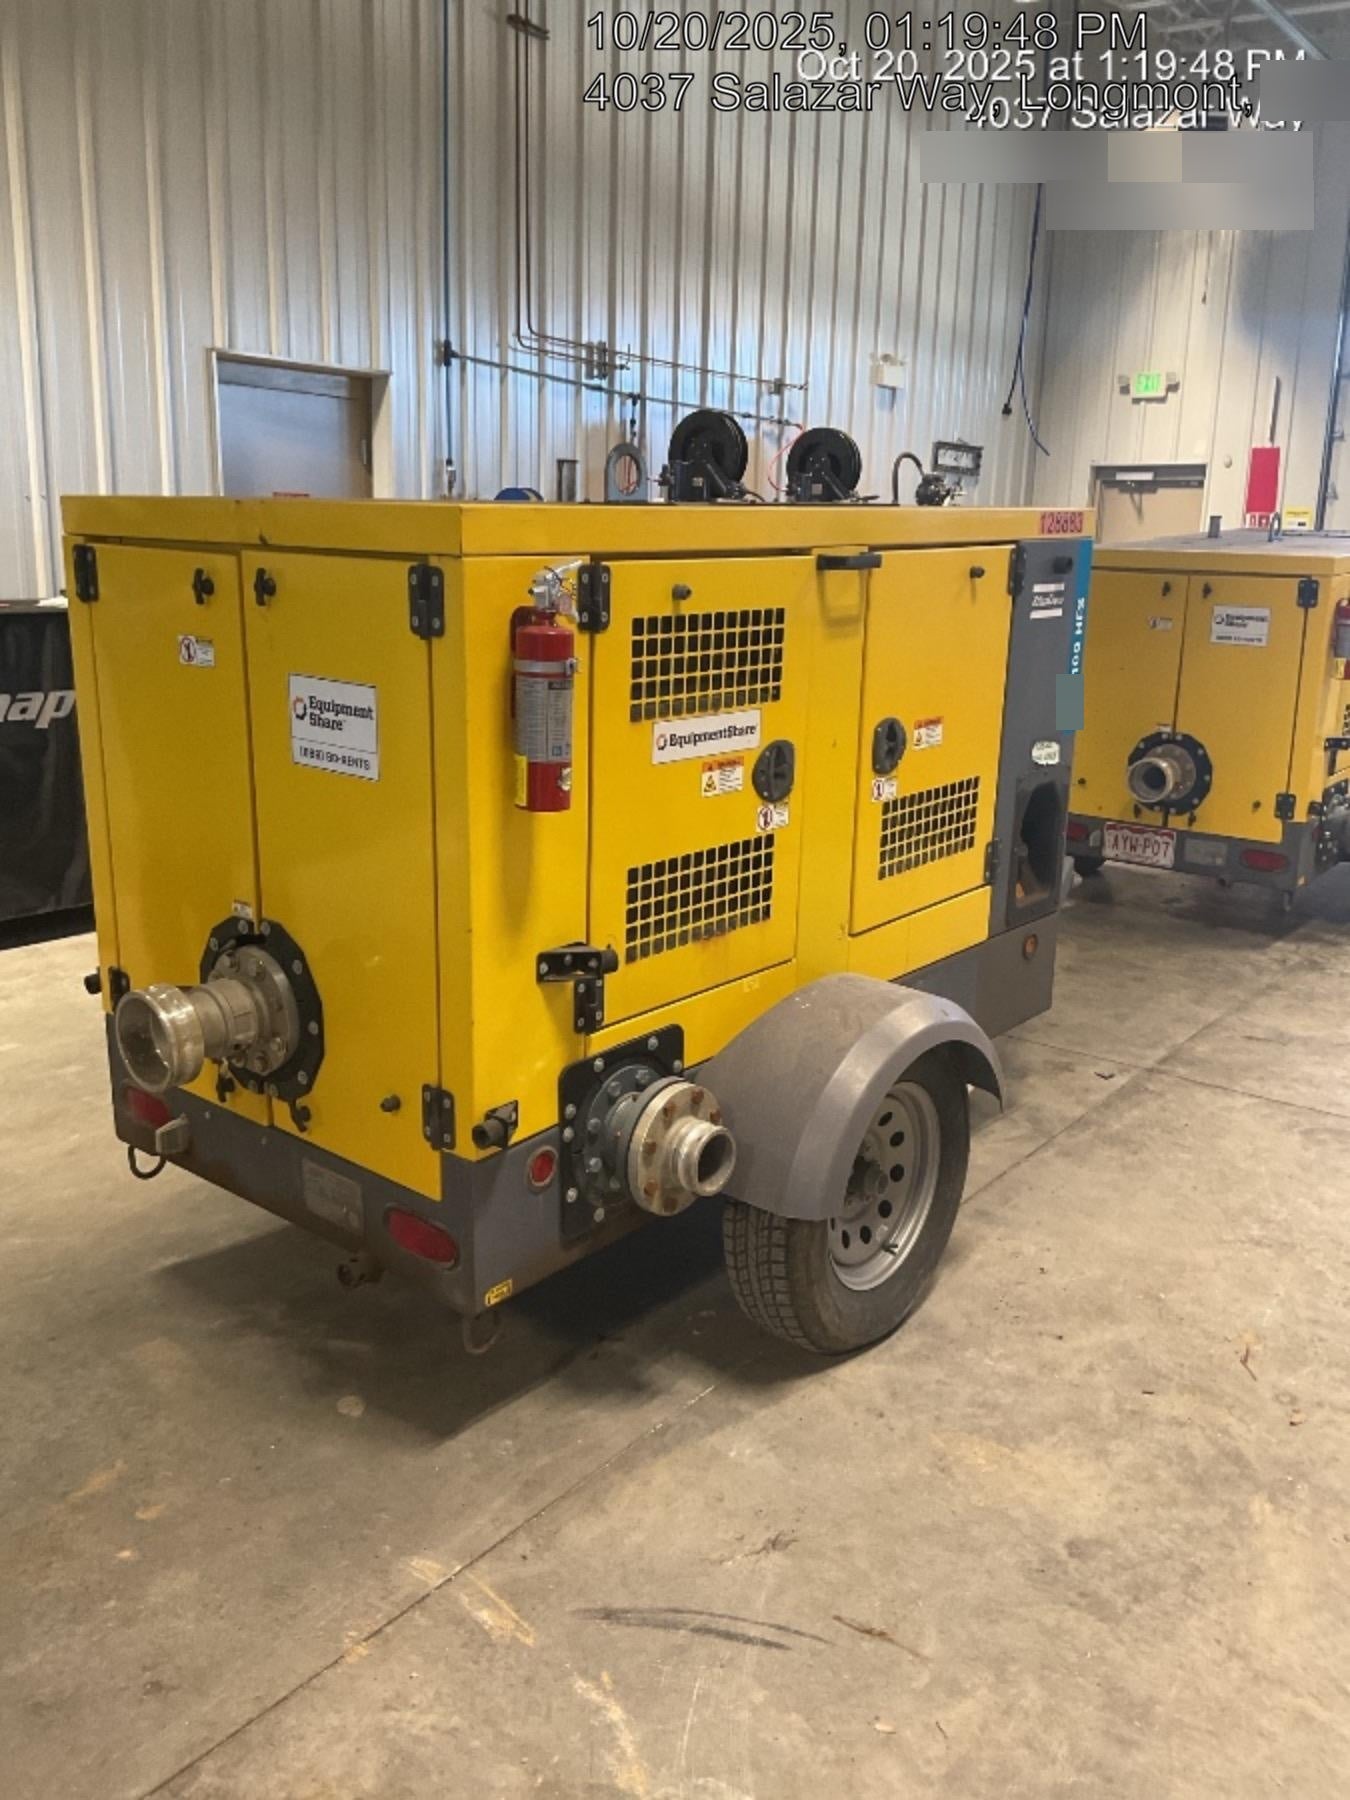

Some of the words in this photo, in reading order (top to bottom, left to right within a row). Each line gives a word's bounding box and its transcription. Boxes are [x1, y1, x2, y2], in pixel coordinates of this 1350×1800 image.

[308, 696, 374, 720] Equipment
[309, 712, 343, 731] Share
[669, 725, 756, 748] EquipmentShare
